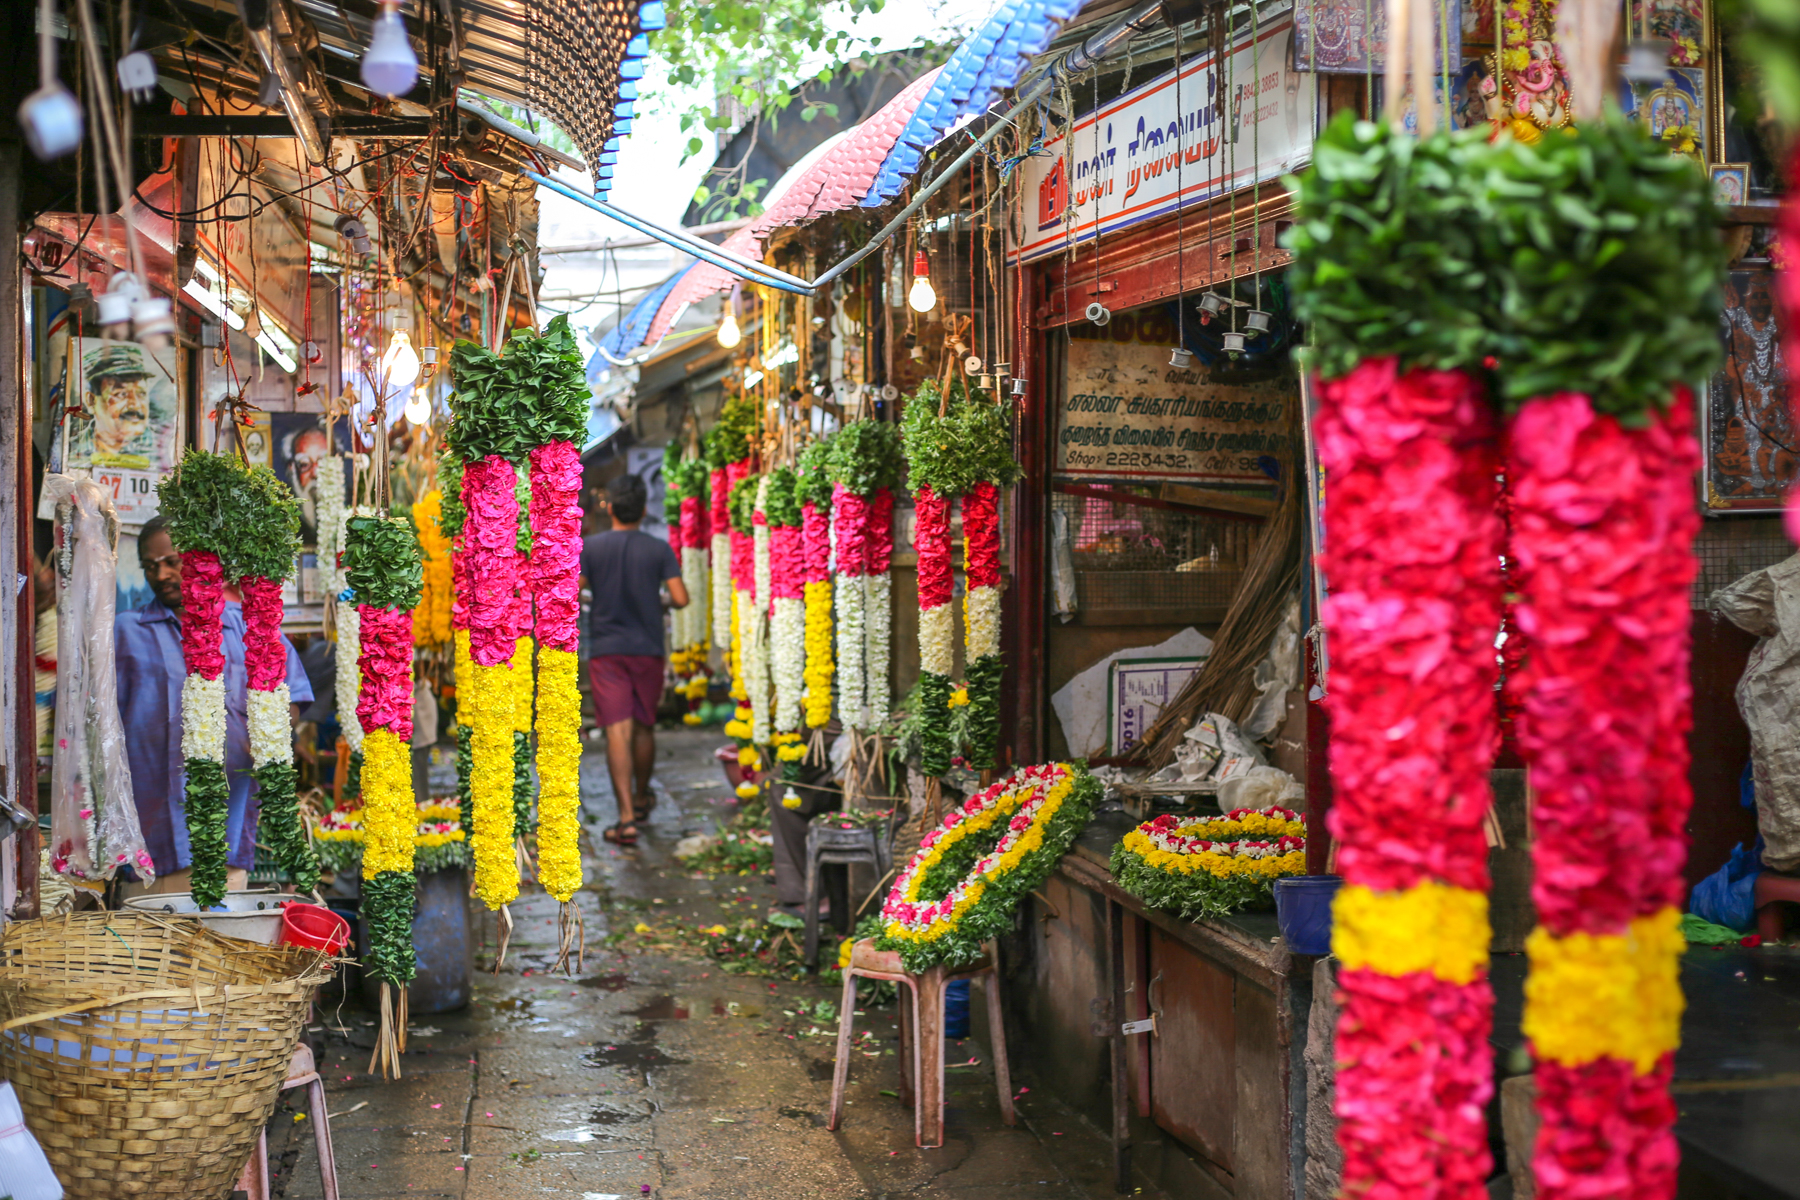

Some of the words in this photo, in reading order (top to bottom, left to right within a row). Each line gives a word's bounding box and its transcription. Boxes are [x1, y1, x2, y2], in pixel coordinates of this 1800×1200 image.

[1066, 390, 1124, 413] எல்லா
[130, 478, 149, 494] 10
[1123, 708, 1135, 751] 2016
